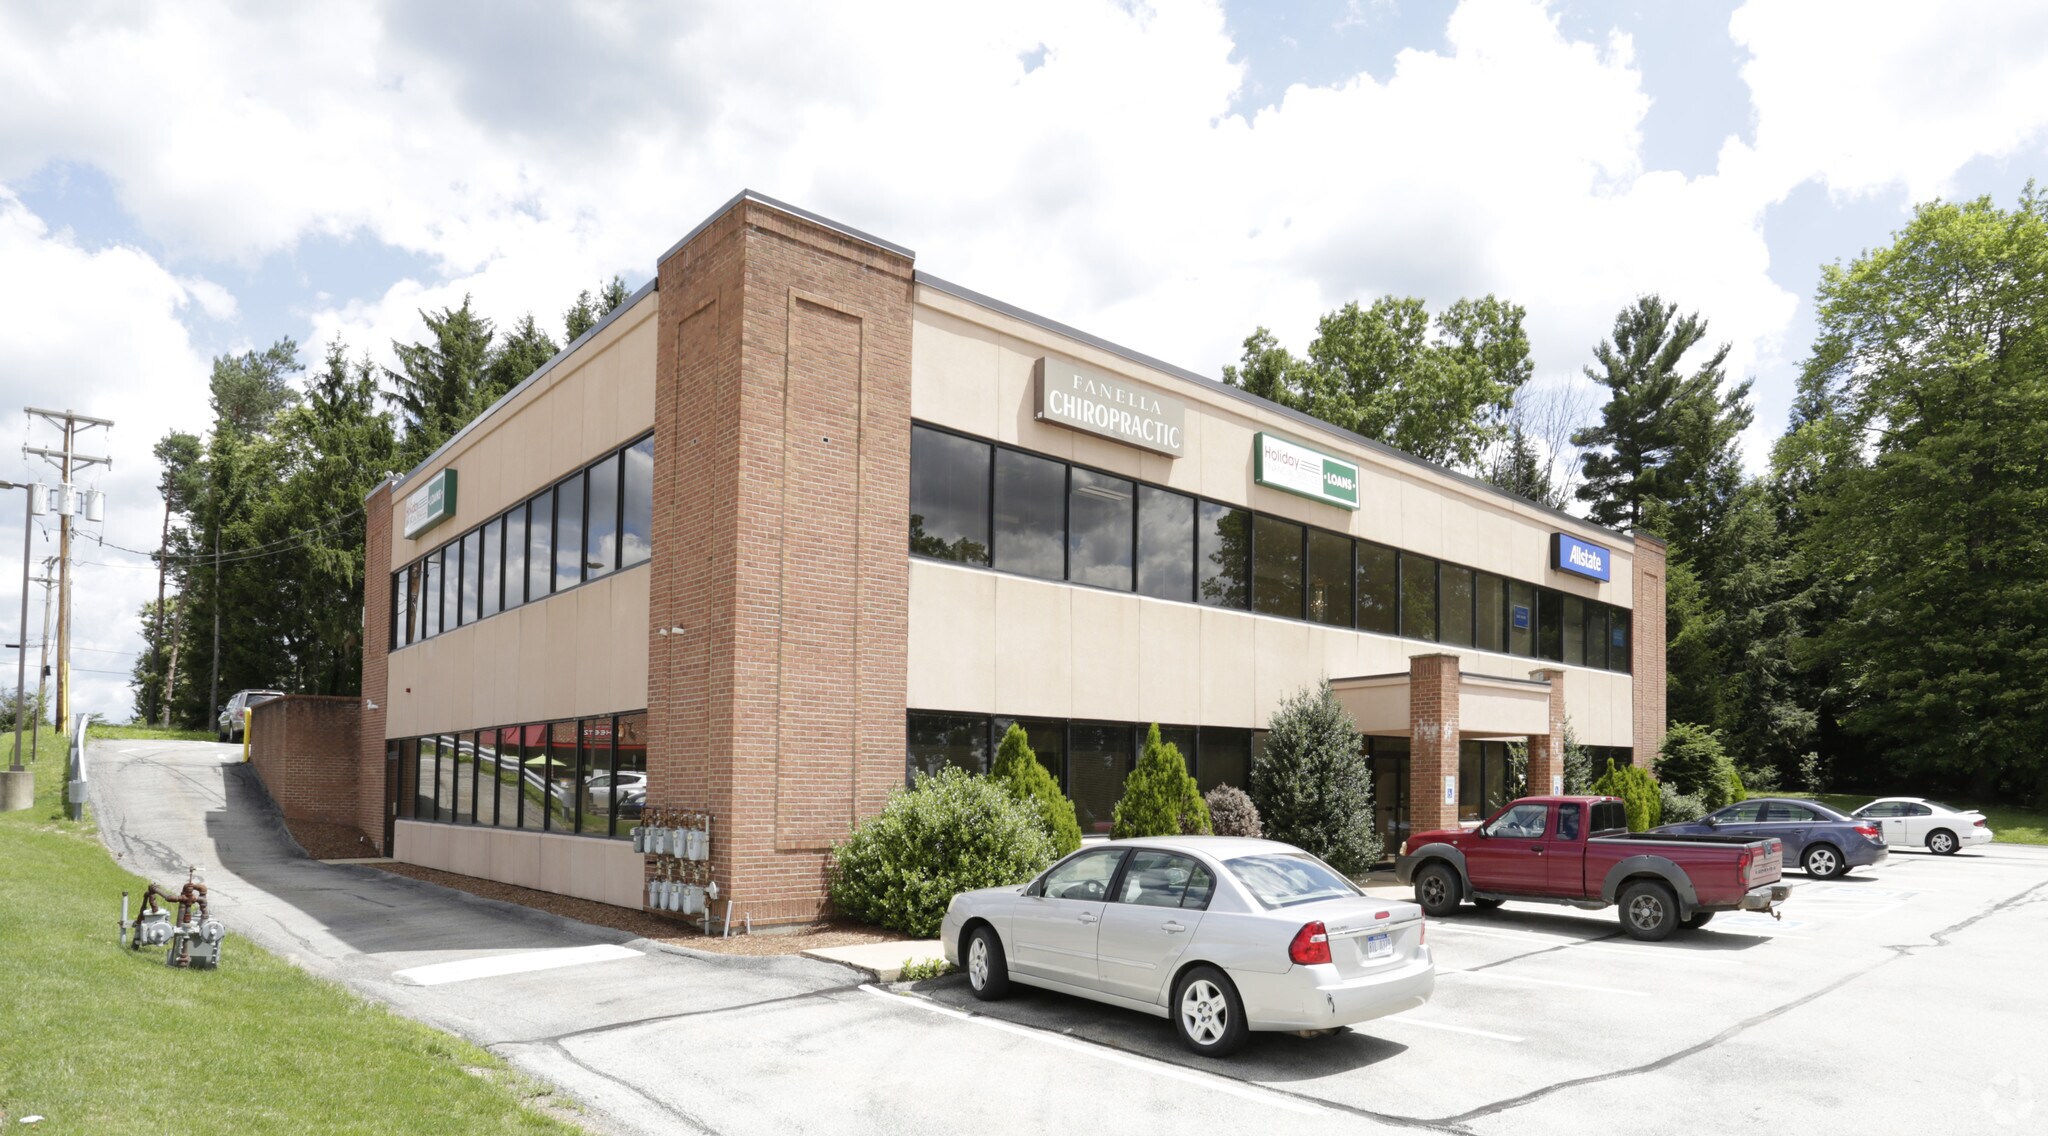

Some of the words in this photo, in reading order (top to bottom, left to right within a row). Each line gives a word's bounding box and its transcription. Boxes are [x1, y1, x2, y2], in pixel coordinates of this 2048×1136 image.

[1073, 374, 1162, 415] FANELLA
[1050, 390, 1180, 449] CHIROPRACTIC
[1265, 444, 1300, 471] Holiday
[1327, 472, 1352, 491] LOANS
[1570, 545, 1602, 571] Allstate
